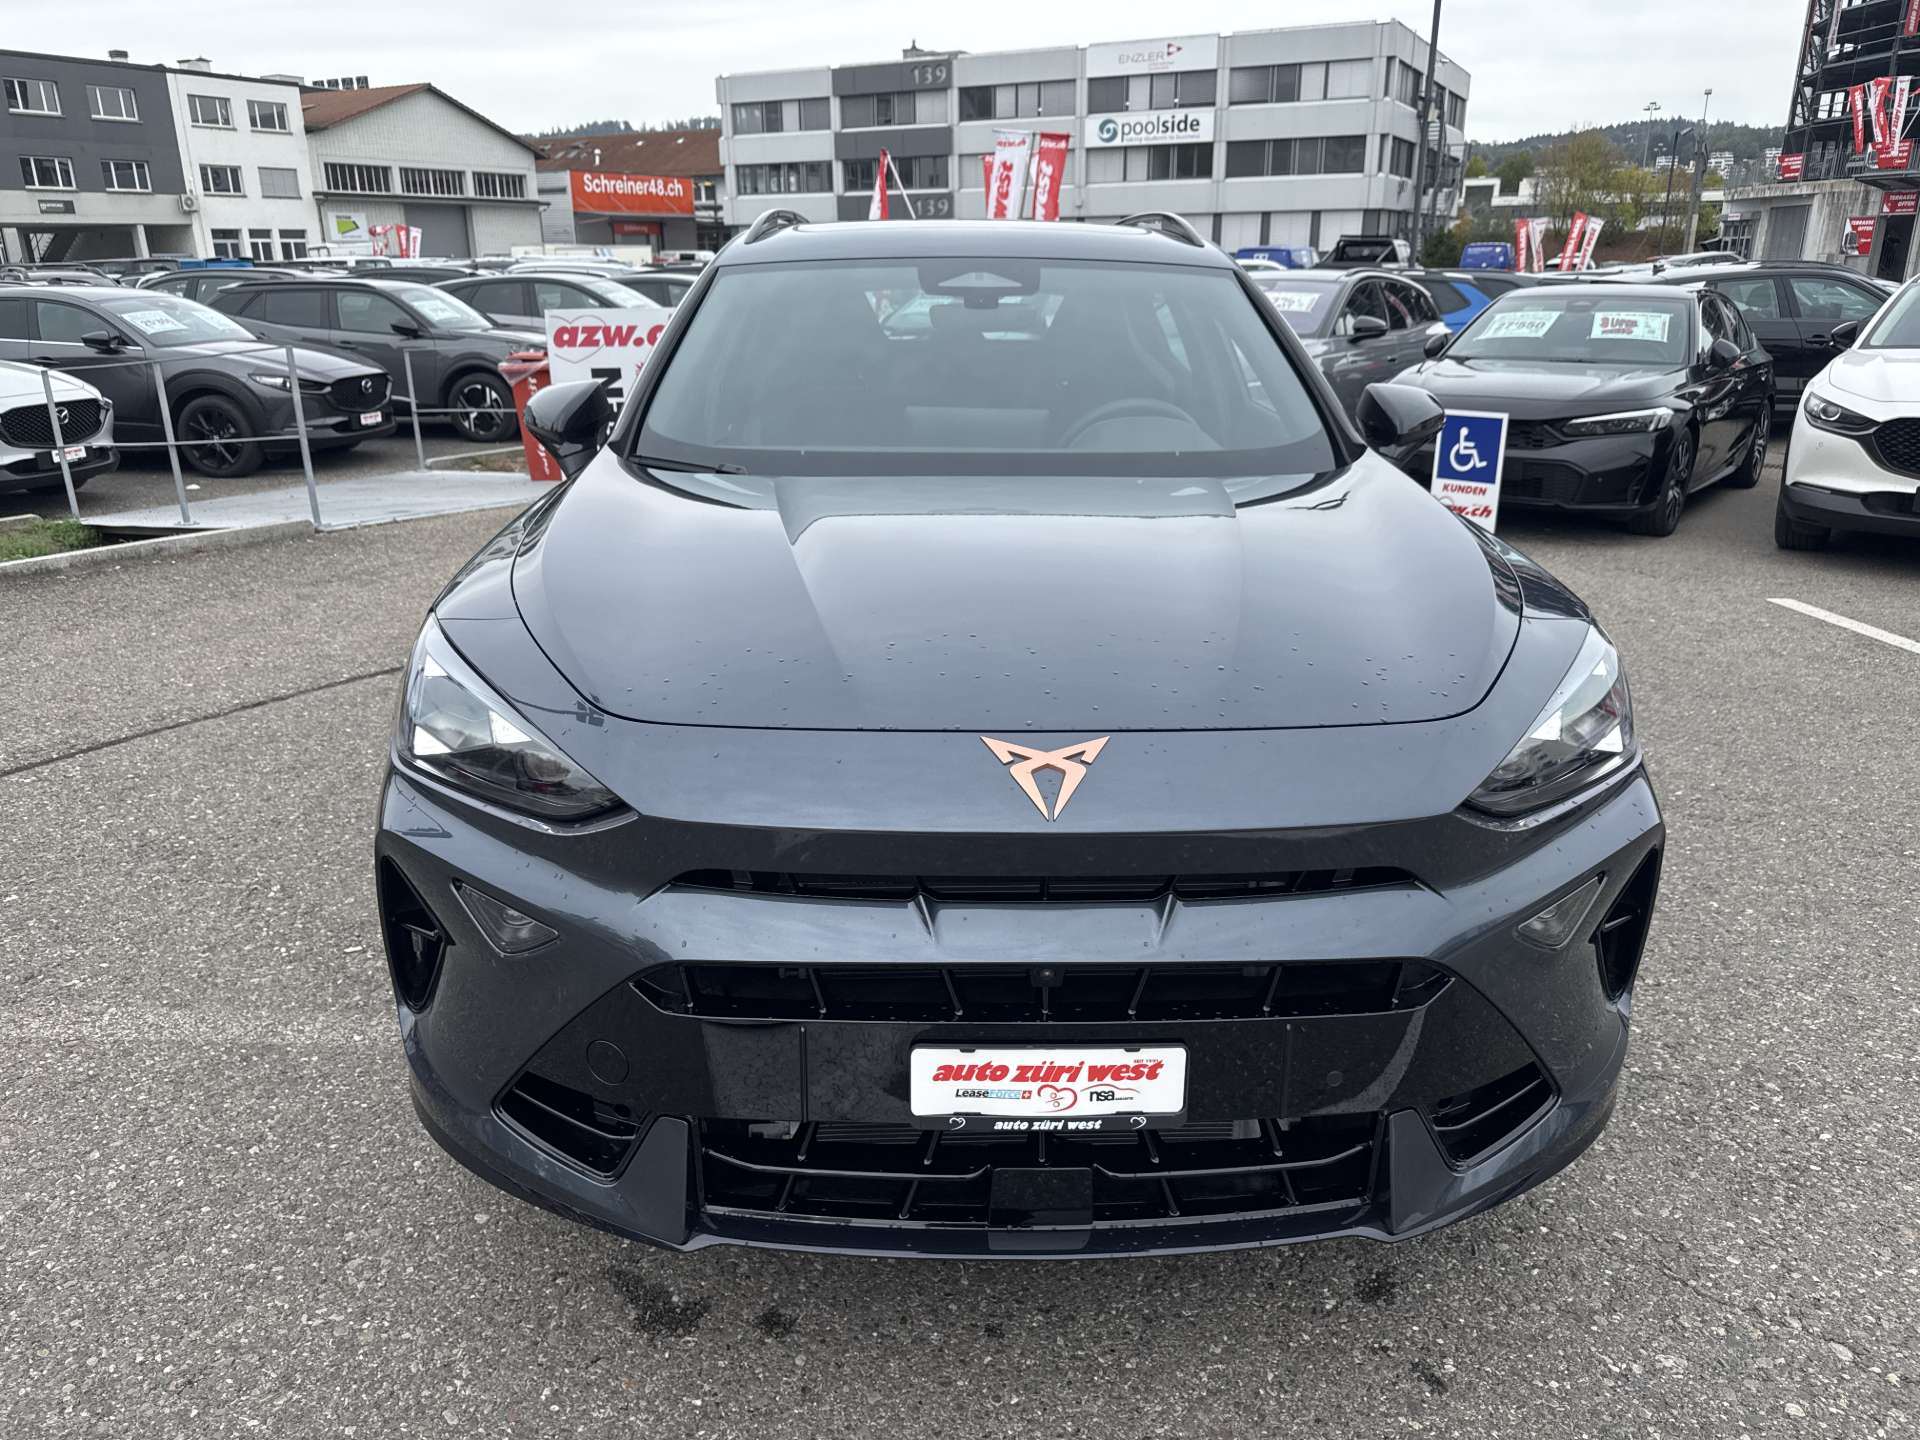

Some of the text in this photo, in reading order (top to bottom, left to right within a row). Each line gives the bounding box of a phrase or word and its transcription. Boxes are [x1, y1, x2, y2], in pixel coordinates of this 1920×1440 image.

[1118, 51, 1165, 65] ENZLER
[913, 66, 947, 85] 139
[1121, 113, 1201, 143] poolside
[583, 172, 684, 197] Schreiner48.ch
[994, 160, 1013, 219] west
[916, 198, 949, 217] 139
[553, 324, 667, 349] azw.c
[1441, 483, 1488, 497] KUNDEN
[932, 1059, 1165, 1083] auto züri west
[1089, 1090, 1115, 1102] nsa
[993, 1118, 1103, 1131] auto züri west
